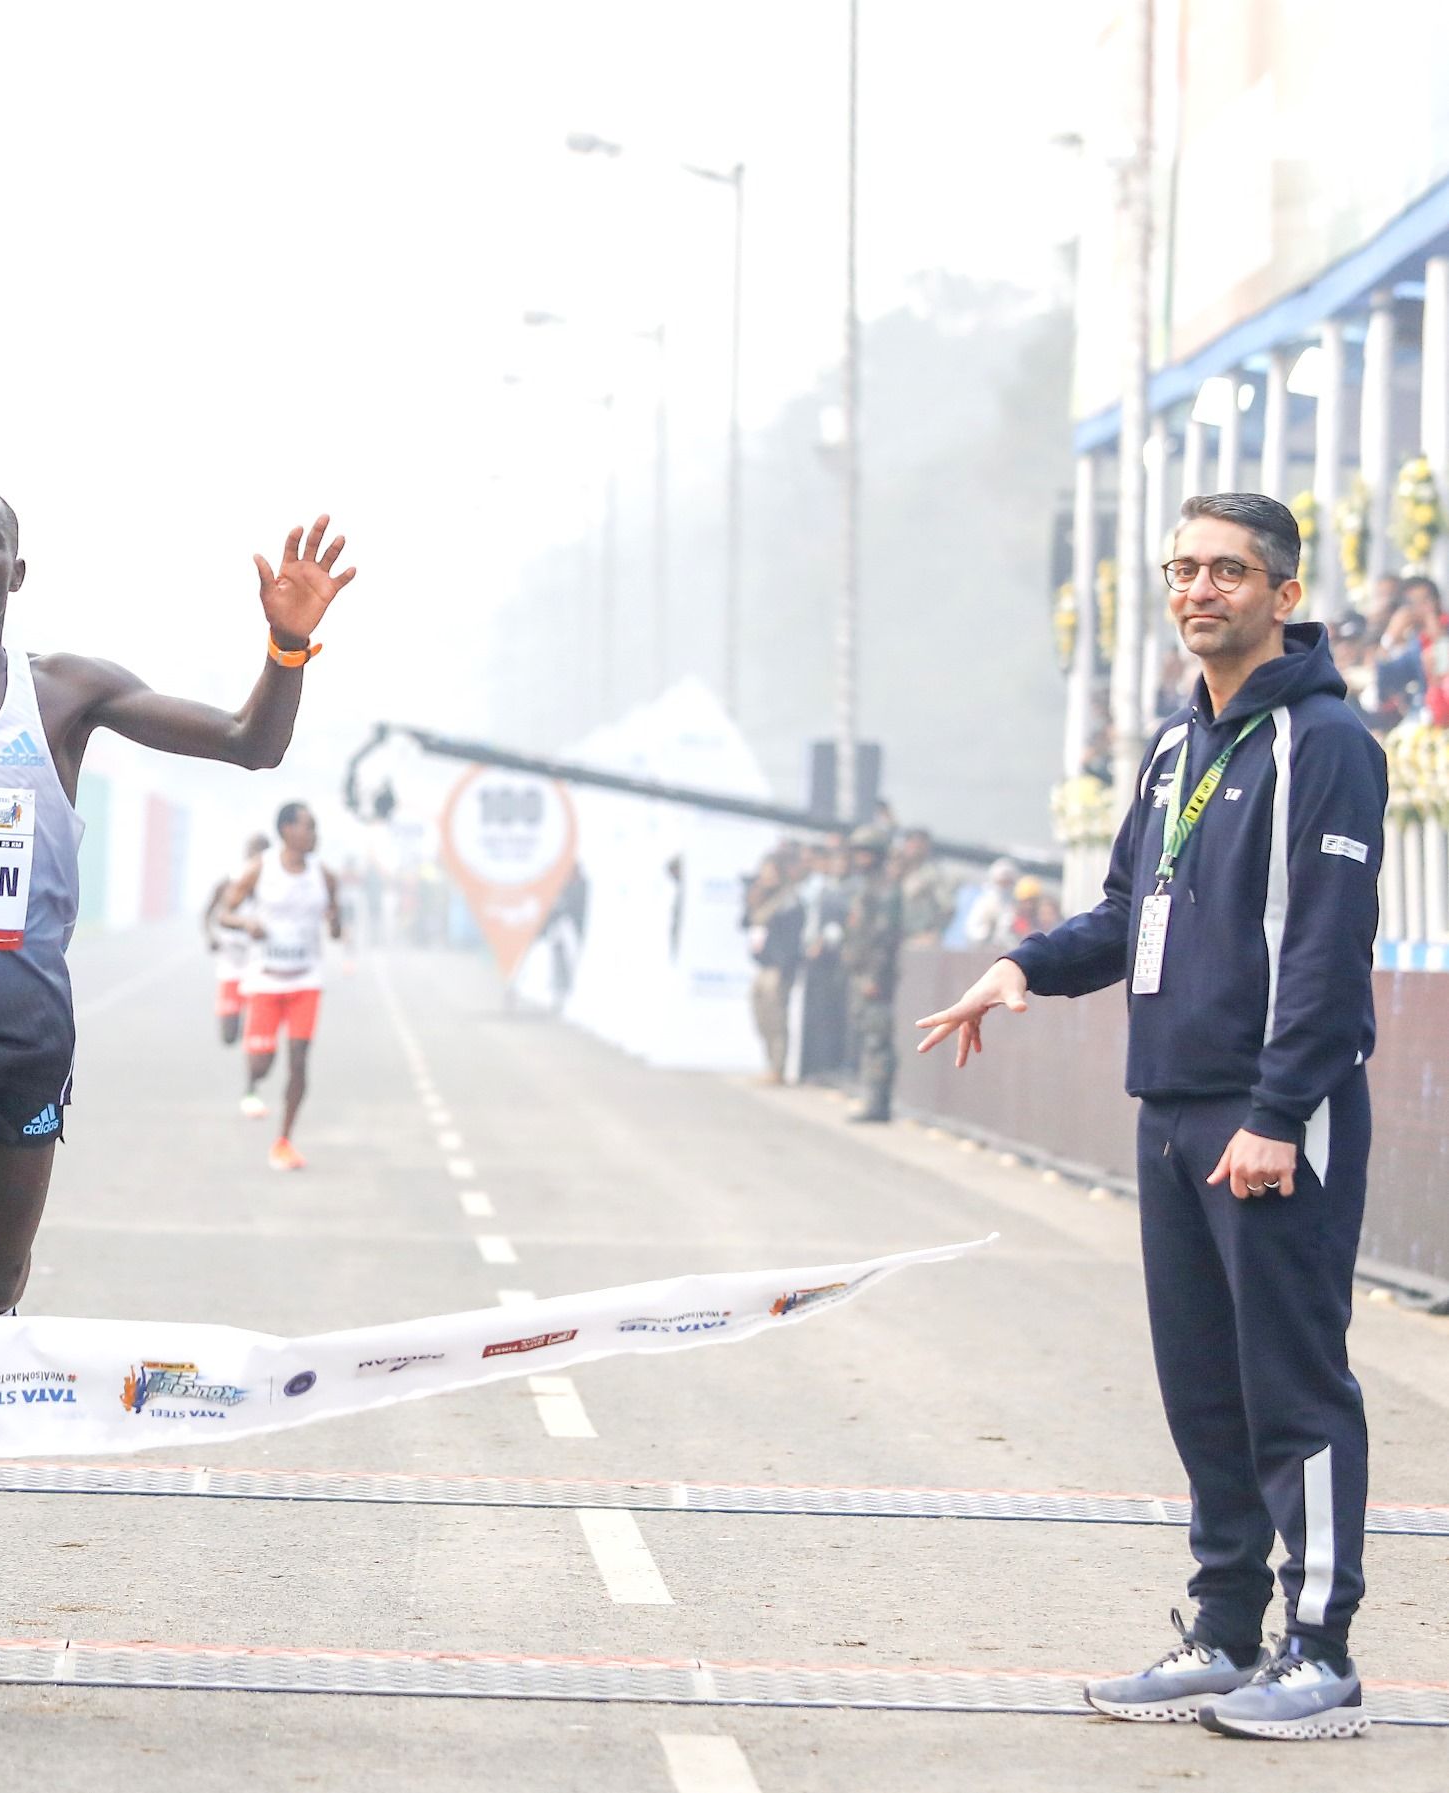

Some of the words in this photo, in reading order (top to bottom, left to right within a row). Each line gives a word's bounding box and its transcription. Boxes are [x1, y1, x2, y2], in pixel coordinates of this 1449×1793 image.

[23, 1119, 59, 1135] adidas
[22, 1388, 76, 1403] TATA
[150, 1409, 185, 1418] STEEL
[189, 1409, 226, 1419] TATA
